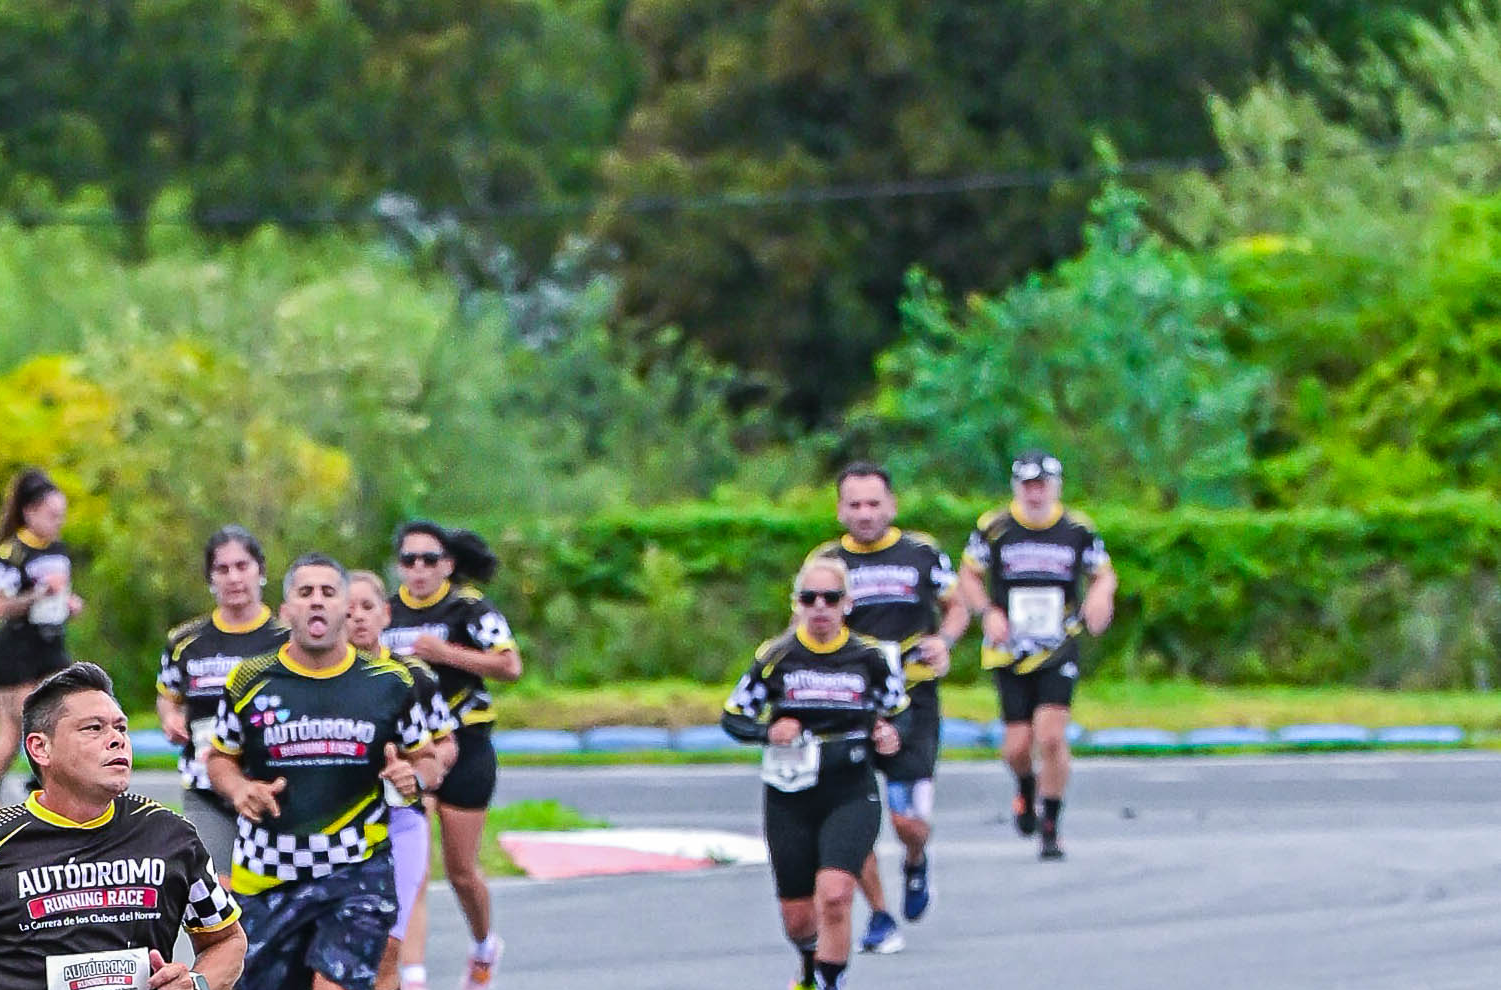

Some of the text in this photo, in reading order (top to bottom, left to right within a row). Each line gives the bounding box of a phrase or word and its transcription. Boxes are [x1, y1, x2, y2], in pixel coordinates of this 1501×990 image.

[17, 857, 166, 898] AUTÓDROMO
[43, 889, 145, 914] RUNNING RACE
[19, 923, 30, 932] La
[31, 919, 62, 931] Carrera
[63, 916, 75, 926] de
[75, 915, 89, 924] los
[90, 913, 118, 924] Clubes
[119, 911, 134, 921] del
[64, 957, 137, 981] AUTÓDROMO
